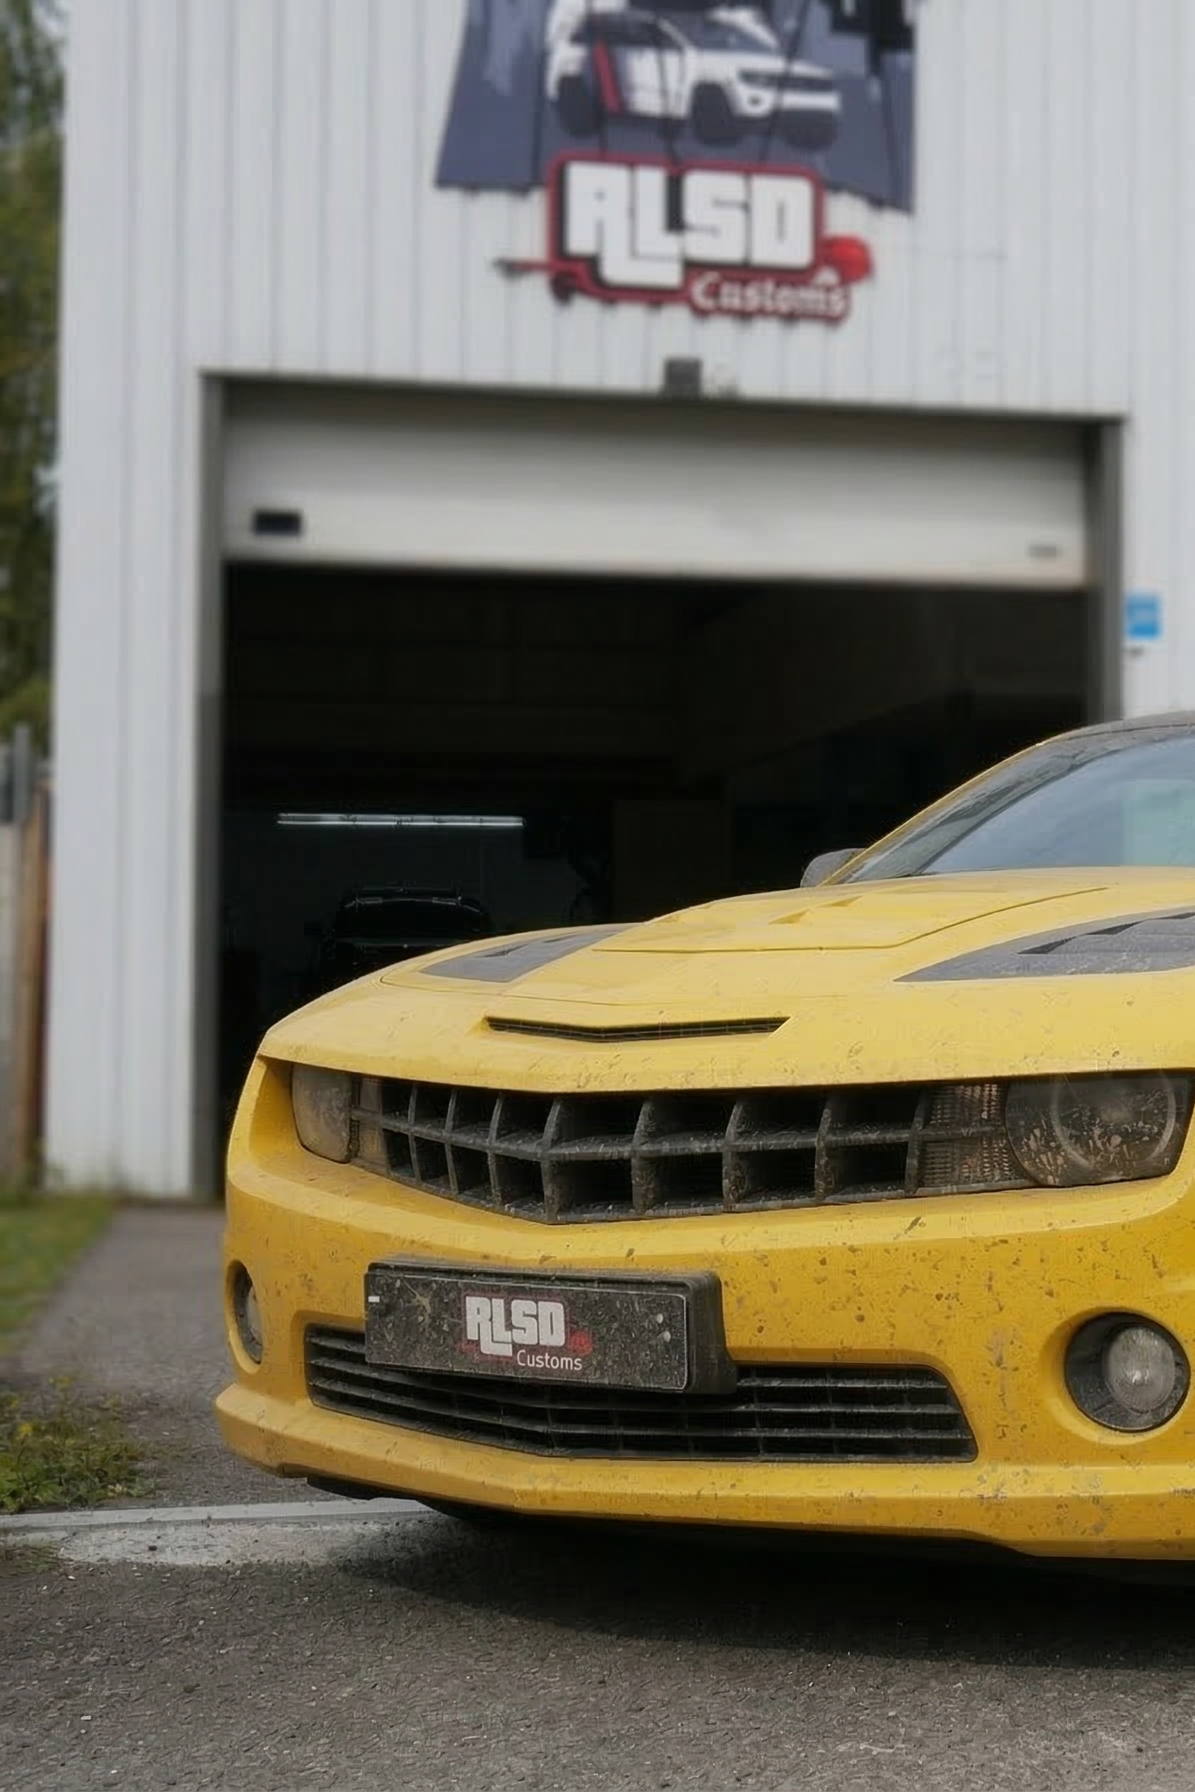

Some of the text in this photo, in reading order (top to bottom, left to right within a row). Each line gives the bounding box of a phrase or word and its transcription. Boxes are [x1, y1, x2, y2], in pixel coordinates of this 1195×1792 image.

[565, 161, 815, 288] RLSD
[691, 270, 846, 318] Customs
[465, 1295, 566, 1357] RLSD
[516, 1349, 583, 1371] Customs
